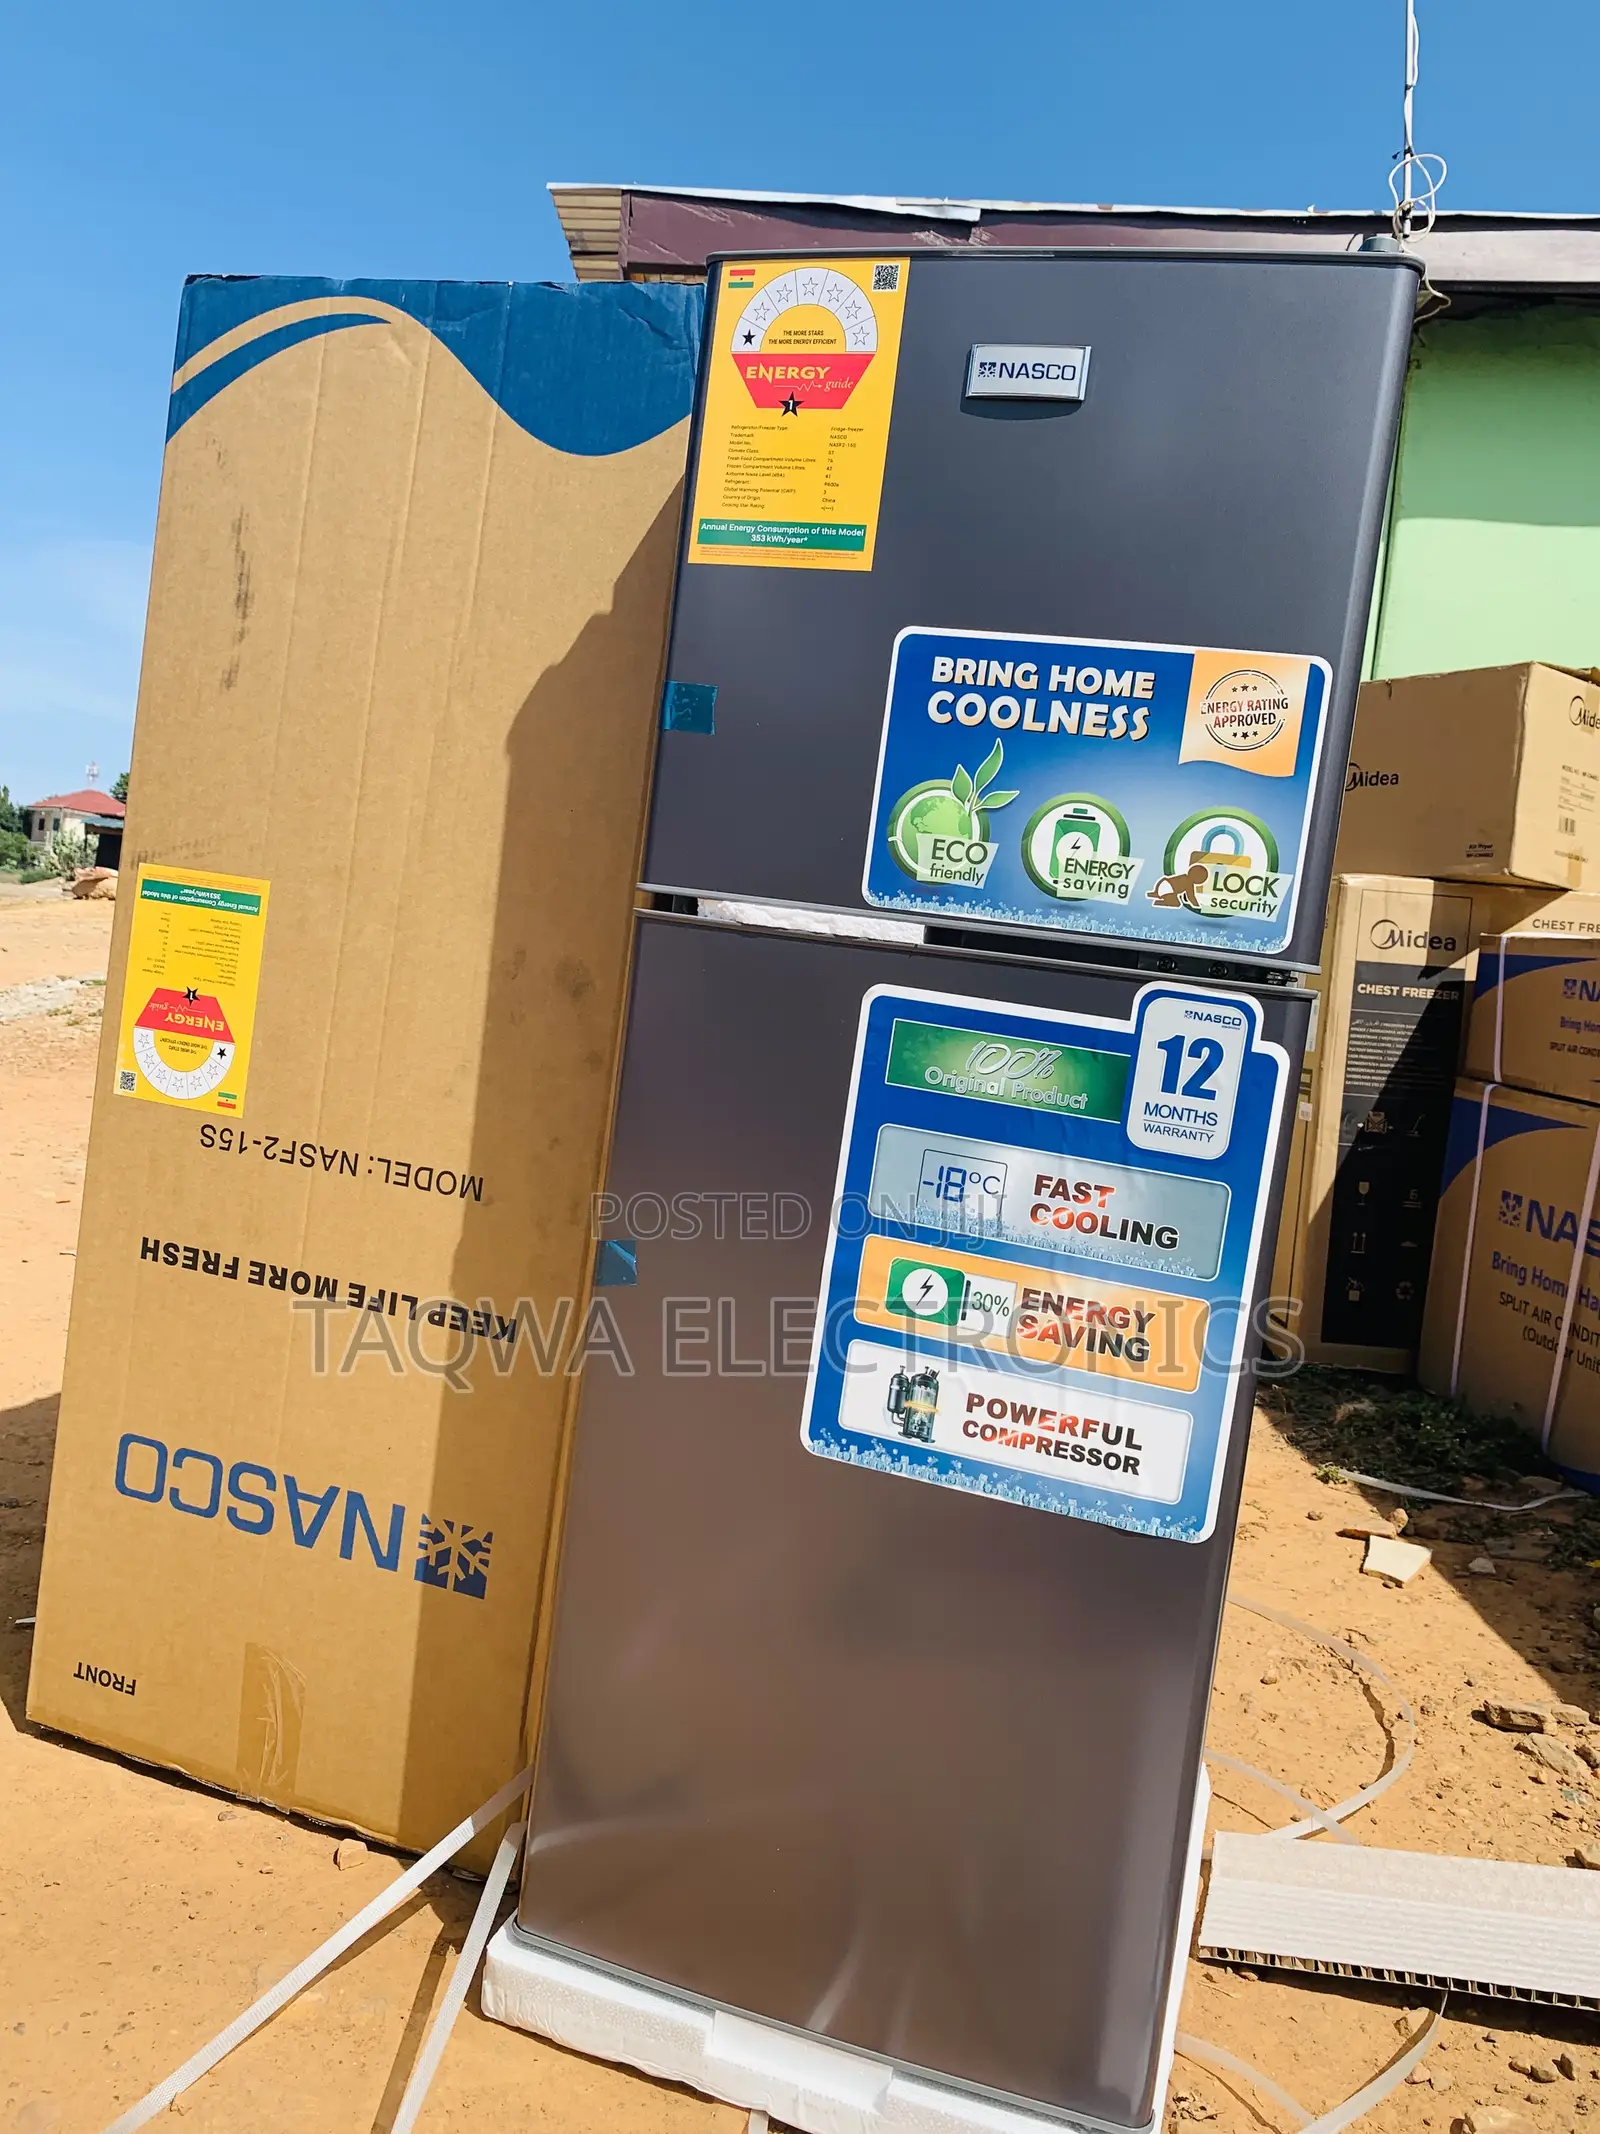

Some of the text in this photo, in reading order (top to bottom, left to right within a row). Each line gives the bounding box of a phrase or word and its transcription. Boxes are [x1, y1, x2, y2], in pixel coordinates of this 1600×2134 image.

[746, 362, 831, 384] ENERGY
[999, 362, 1076, 380] NASCO
[824, 377, 854, 392] guide
[788, 400, 793, 410] 1
[701, 522, 727, 530] Annual
[729, 524, 755, 533] Energy
[758, 525, 809, 535] Consumption
[822, 527, 836, 535] this
[838, 529, 864, 537] Model
[931, 656, 1156, 700] BRING HOME
[927, 691, 1151, 741] COOLNESS
[1247, 698, 1288, 711] RATING
[1214, 713, 1276, 728] APPROVED
[931, 838, 988, 865] ECO
[929, 863, 985, 886] friendly
[1063, 858, 1135, 880] ENERGY
[1063, 877, 1129, 898] saving
[1212, 870, 1280, 898] LOCK
[179, 895, 216, 906] Consumption
[217, 900, 237, 909] Energy
[238, 905, 258, 913] Annual
[1210, 895, 1278, 917] security
[1370, 919, 1457, 951] Midea
[1532, 919, 1574, 931] CHEST
[1357, 983, 1459, 1000] CHEST FREEZER
[148, 1002, 169, 1012] guide
[1193, 1012, 1242, 1026] NASCO
[164, 1012, 224, 1032] ENERGY
[1560, 1016, 1581, 1034] Bring
[965, 1040, 1062, 1079] 100%
[1157, 1034, 1224, 1101] 12
[925, 1066, 1088, 1109] Original Product
[1144, 1102, 1218, 1126] MONTHS
[1143, 1123, 1214, 1143] WARRANTY
[200, 1123, 484, 1202] MODEL: NASF2-15S
[1034, 1174, 1115, 1209] FAST
[1029, 1203, 1180, 1251] COOLING
[1492, 1251, 1527, 1286] Bring
[140, 1236, 517, 1343] KEEP LIFE MORE FRESH
[971, 1292, 1010, 1318] 30%
[1021, 1287, 1156, 1334] ENERGY
[1499, 1291, 1529, 1314] SPLIT
[1532, 1305, 1552, 1326] AIR
[1016, 1315, 1151, 1364] SAVING
[966, 1393, 1144, 1452] POWERFUL
[962, 1420, 1141, 1477] COMPRESSOR
[114, 1432, 406, 1572] NASCO
[73, 1661, 137, 1696] FRONT
